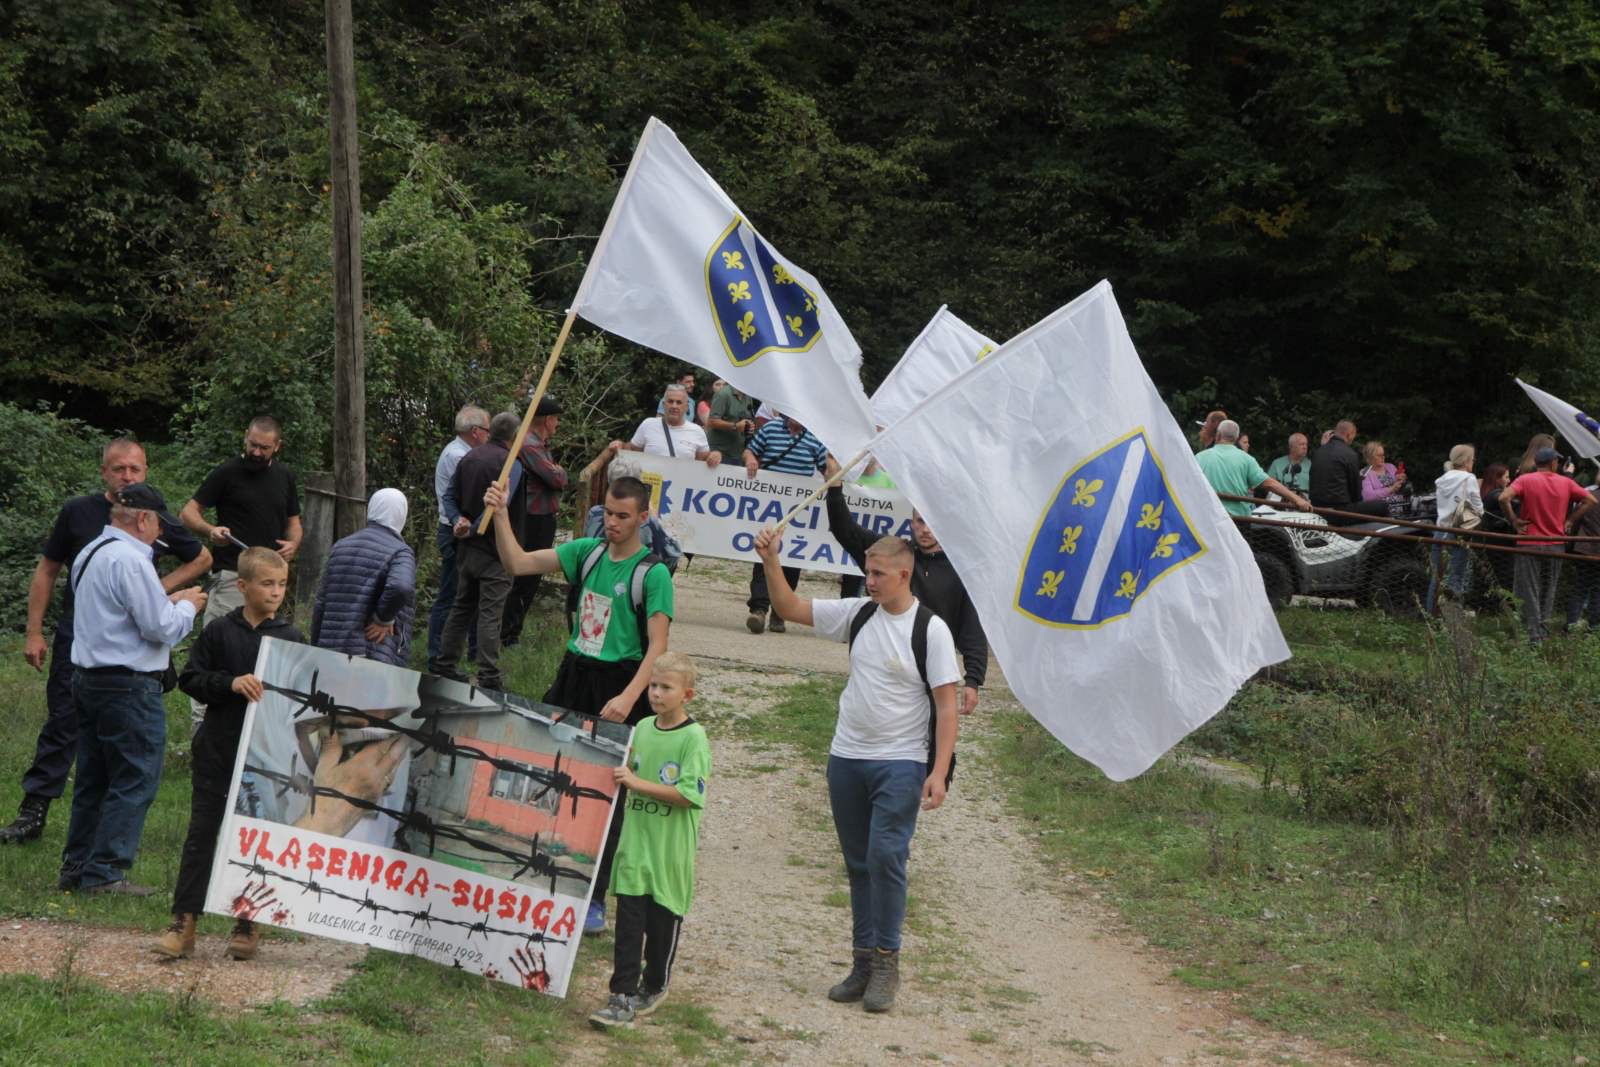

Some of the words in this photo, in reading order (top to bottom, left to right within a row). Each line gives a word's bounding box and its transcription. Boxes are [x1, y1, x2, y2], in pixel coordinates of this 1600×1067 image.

[681, 488, 820, 530] KORACI
[850, 512, 913, 540] IRA
[717, 477, 792, 496] UDRUŽENJE
[796, 488, 893, 511] PRJLJSTVA
[307, 911, 365, 935] VLASENICA
[386, 928, 453, 954] SEPTEMBAR
